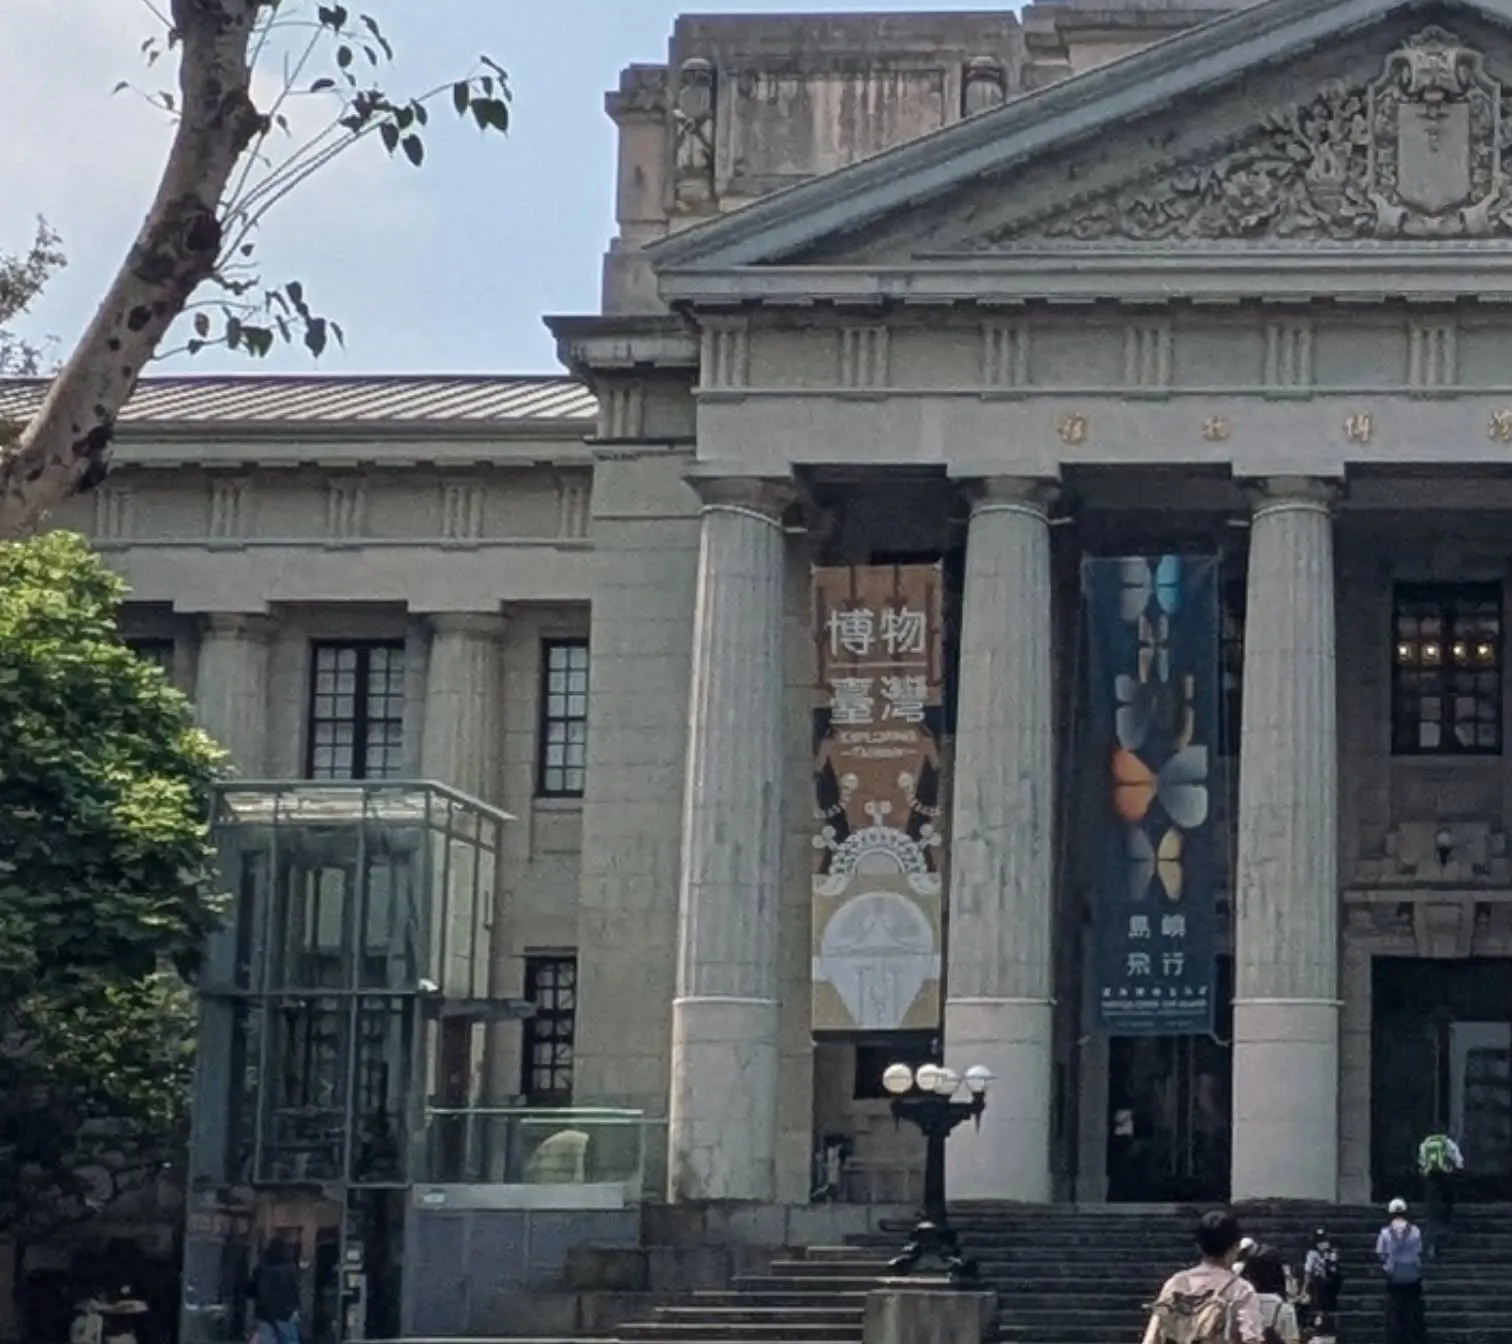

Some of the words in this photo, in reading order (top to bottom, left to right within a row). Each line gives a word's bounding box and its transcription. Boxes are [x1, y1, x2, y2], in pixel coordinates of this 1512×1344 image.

[825, 607, 927, 656] 博物
[829, 675, 928, 725] 臺灣
[1127, 952, 1185, 977] 飛行
